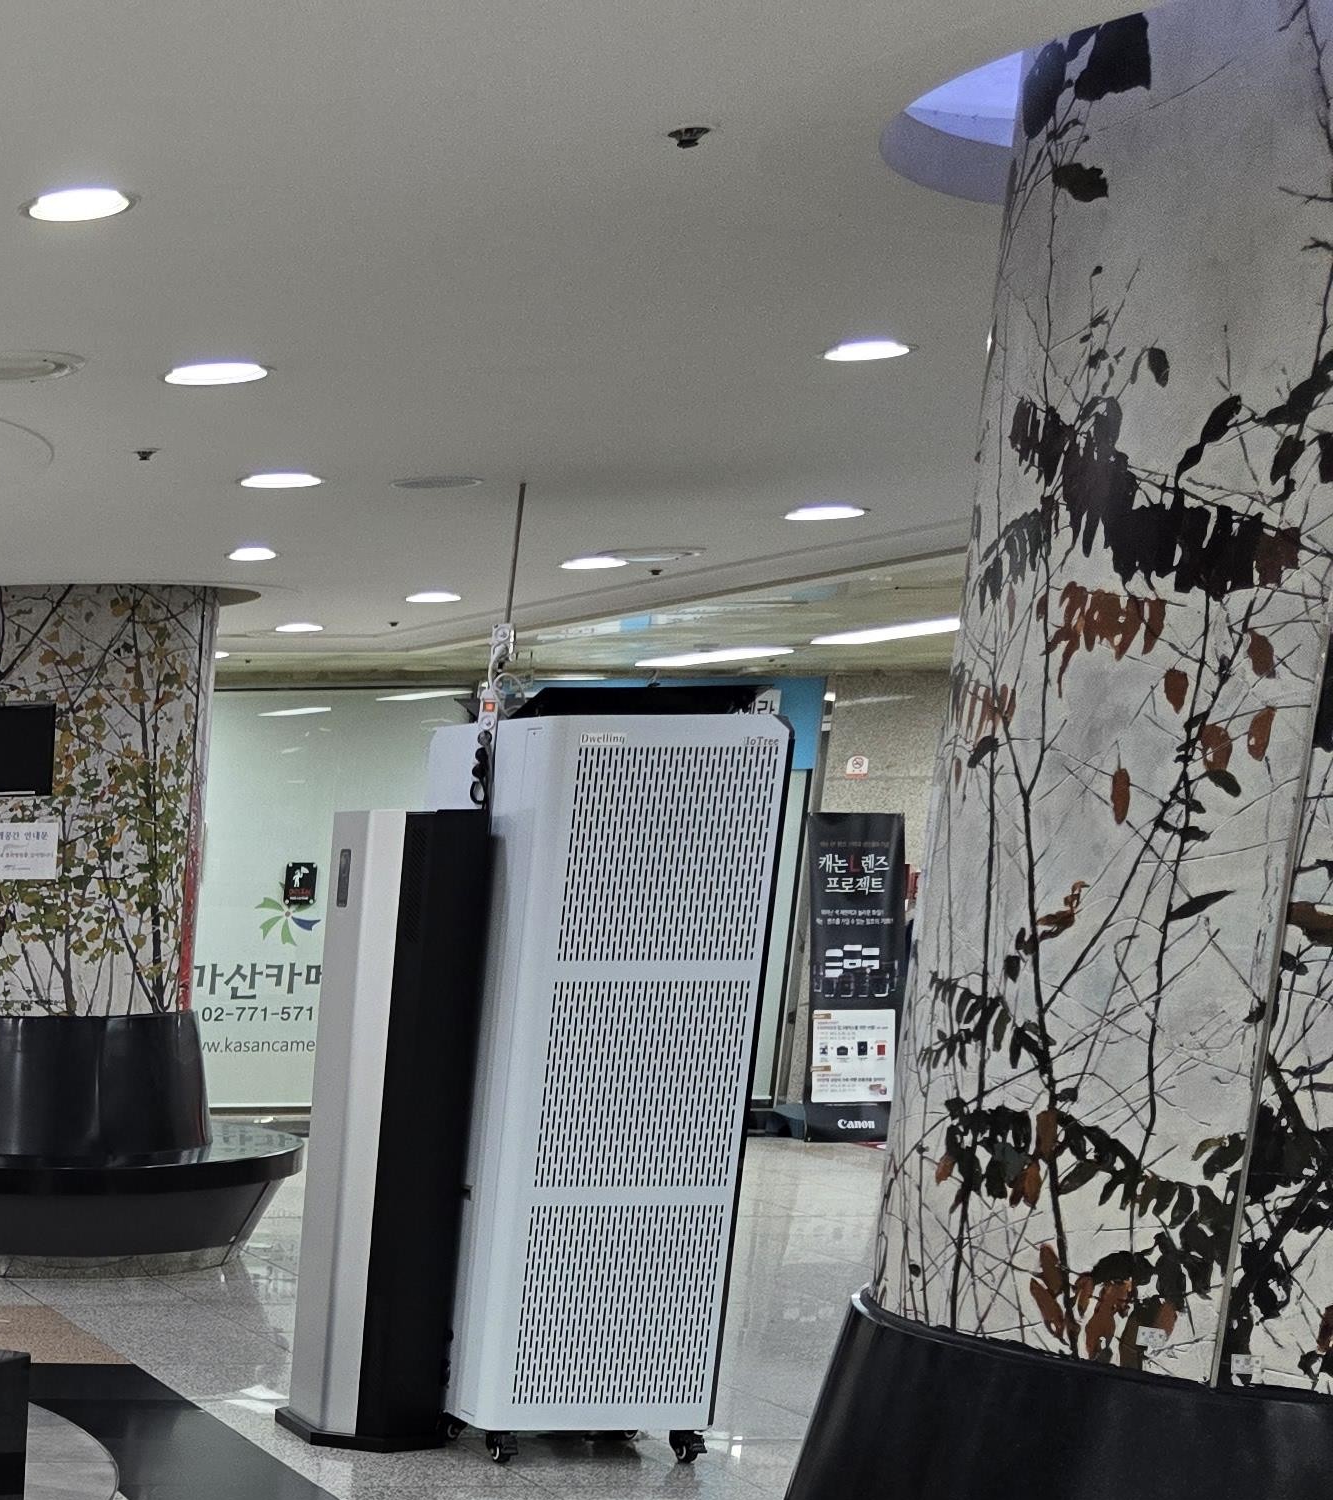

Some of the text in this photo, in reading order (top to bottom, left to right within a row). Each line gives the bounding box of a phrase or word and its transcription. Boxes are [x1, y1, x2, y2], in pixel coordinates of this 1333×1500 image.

[580, 733, 626, 745] Dwelling
[744, 735, 780, 746] IoTree
[818, 853, 849, 874] 캐논
[861, 853, 890, 874] 렌즈
[824, 875, 885, 896] 프로젝트
[201, 1006, 314, 1022] 02-771-571
[837, 1118, 876, 1130] Canon
